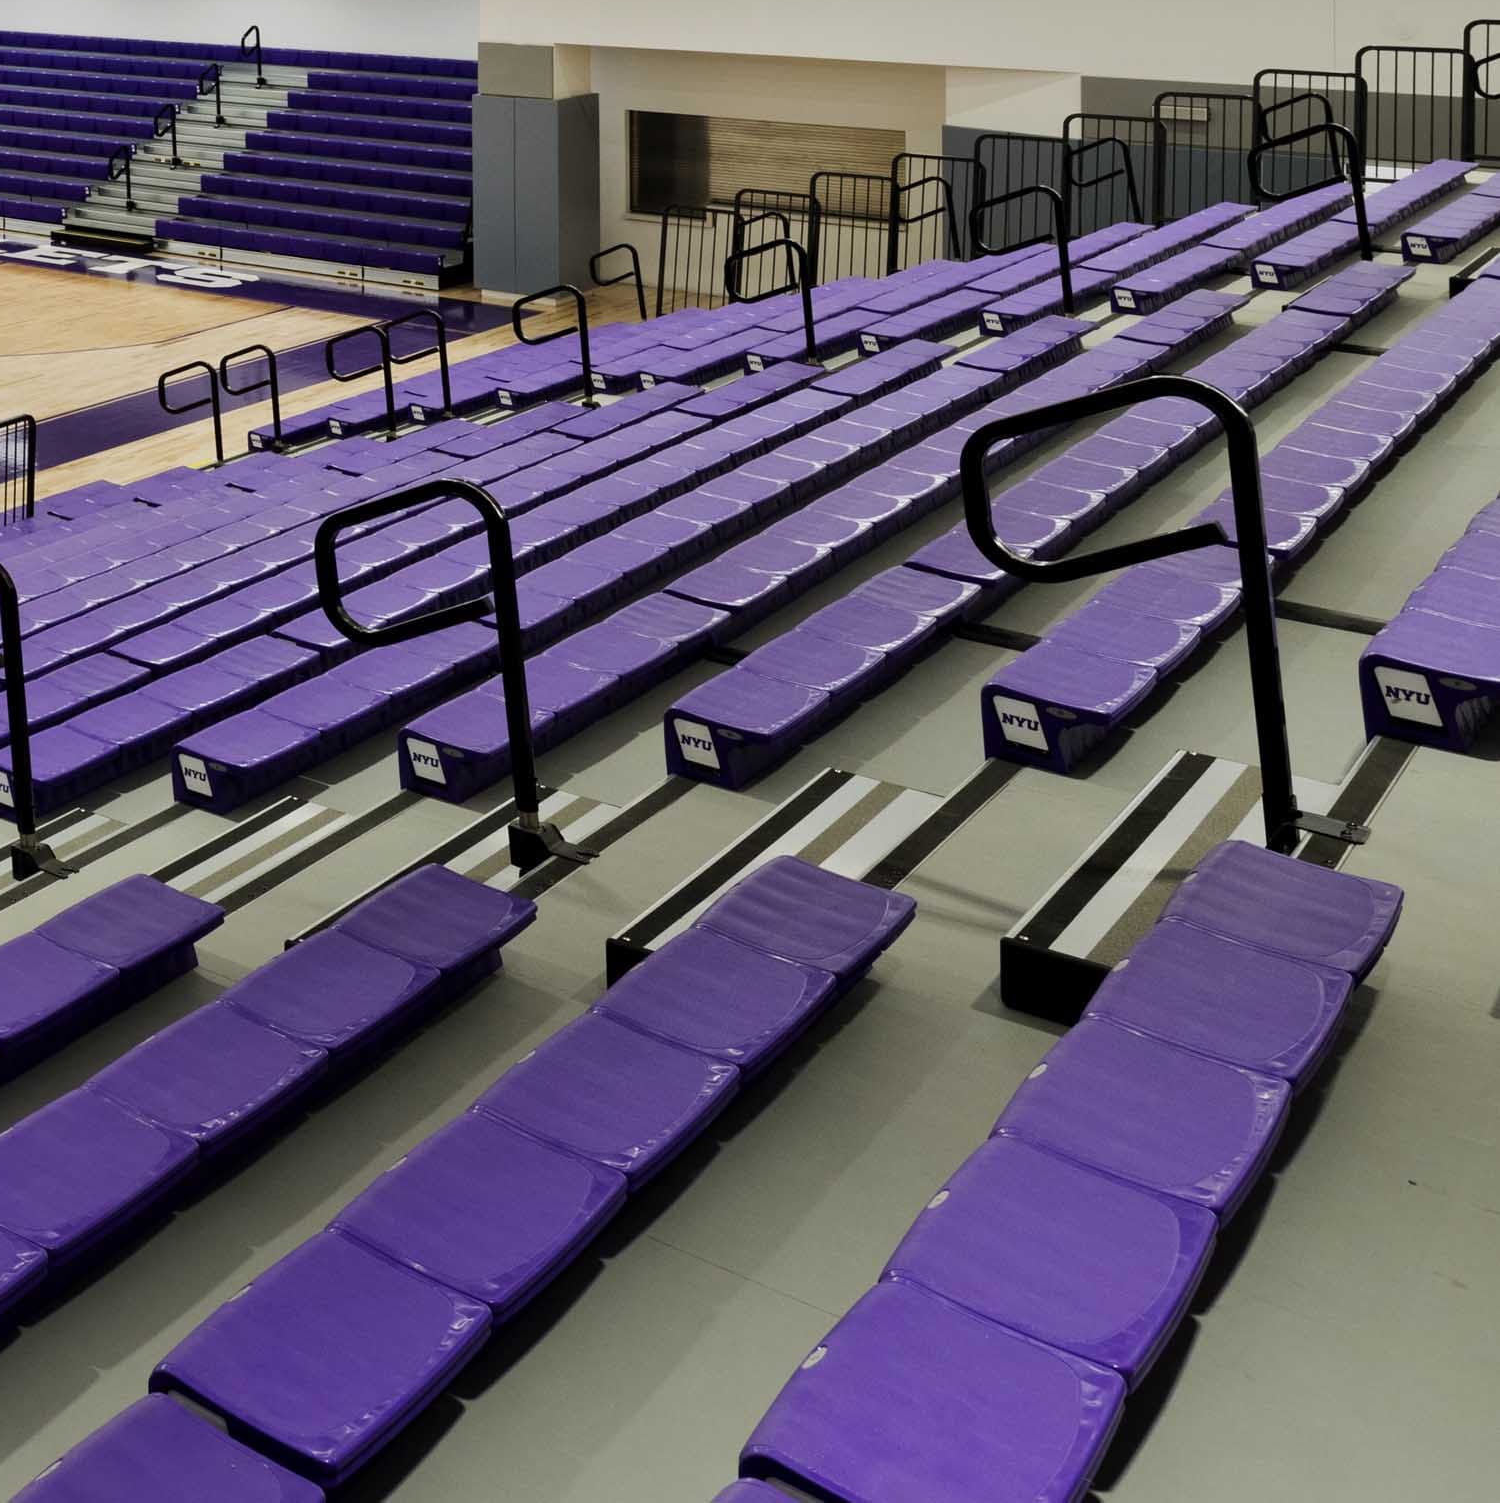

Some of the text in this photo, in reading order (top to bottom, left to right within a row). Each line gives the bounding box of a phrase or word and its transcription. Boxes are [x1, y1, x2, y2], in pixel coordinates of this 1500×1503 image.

[1385, 684, 1431, 706] NYU
[1002, 712, 1040, 732] NYU
[681, 734, 714, 753] NYU
[412, 752, 440, 769] NYU
[184, 767, 207, 782] NYU
